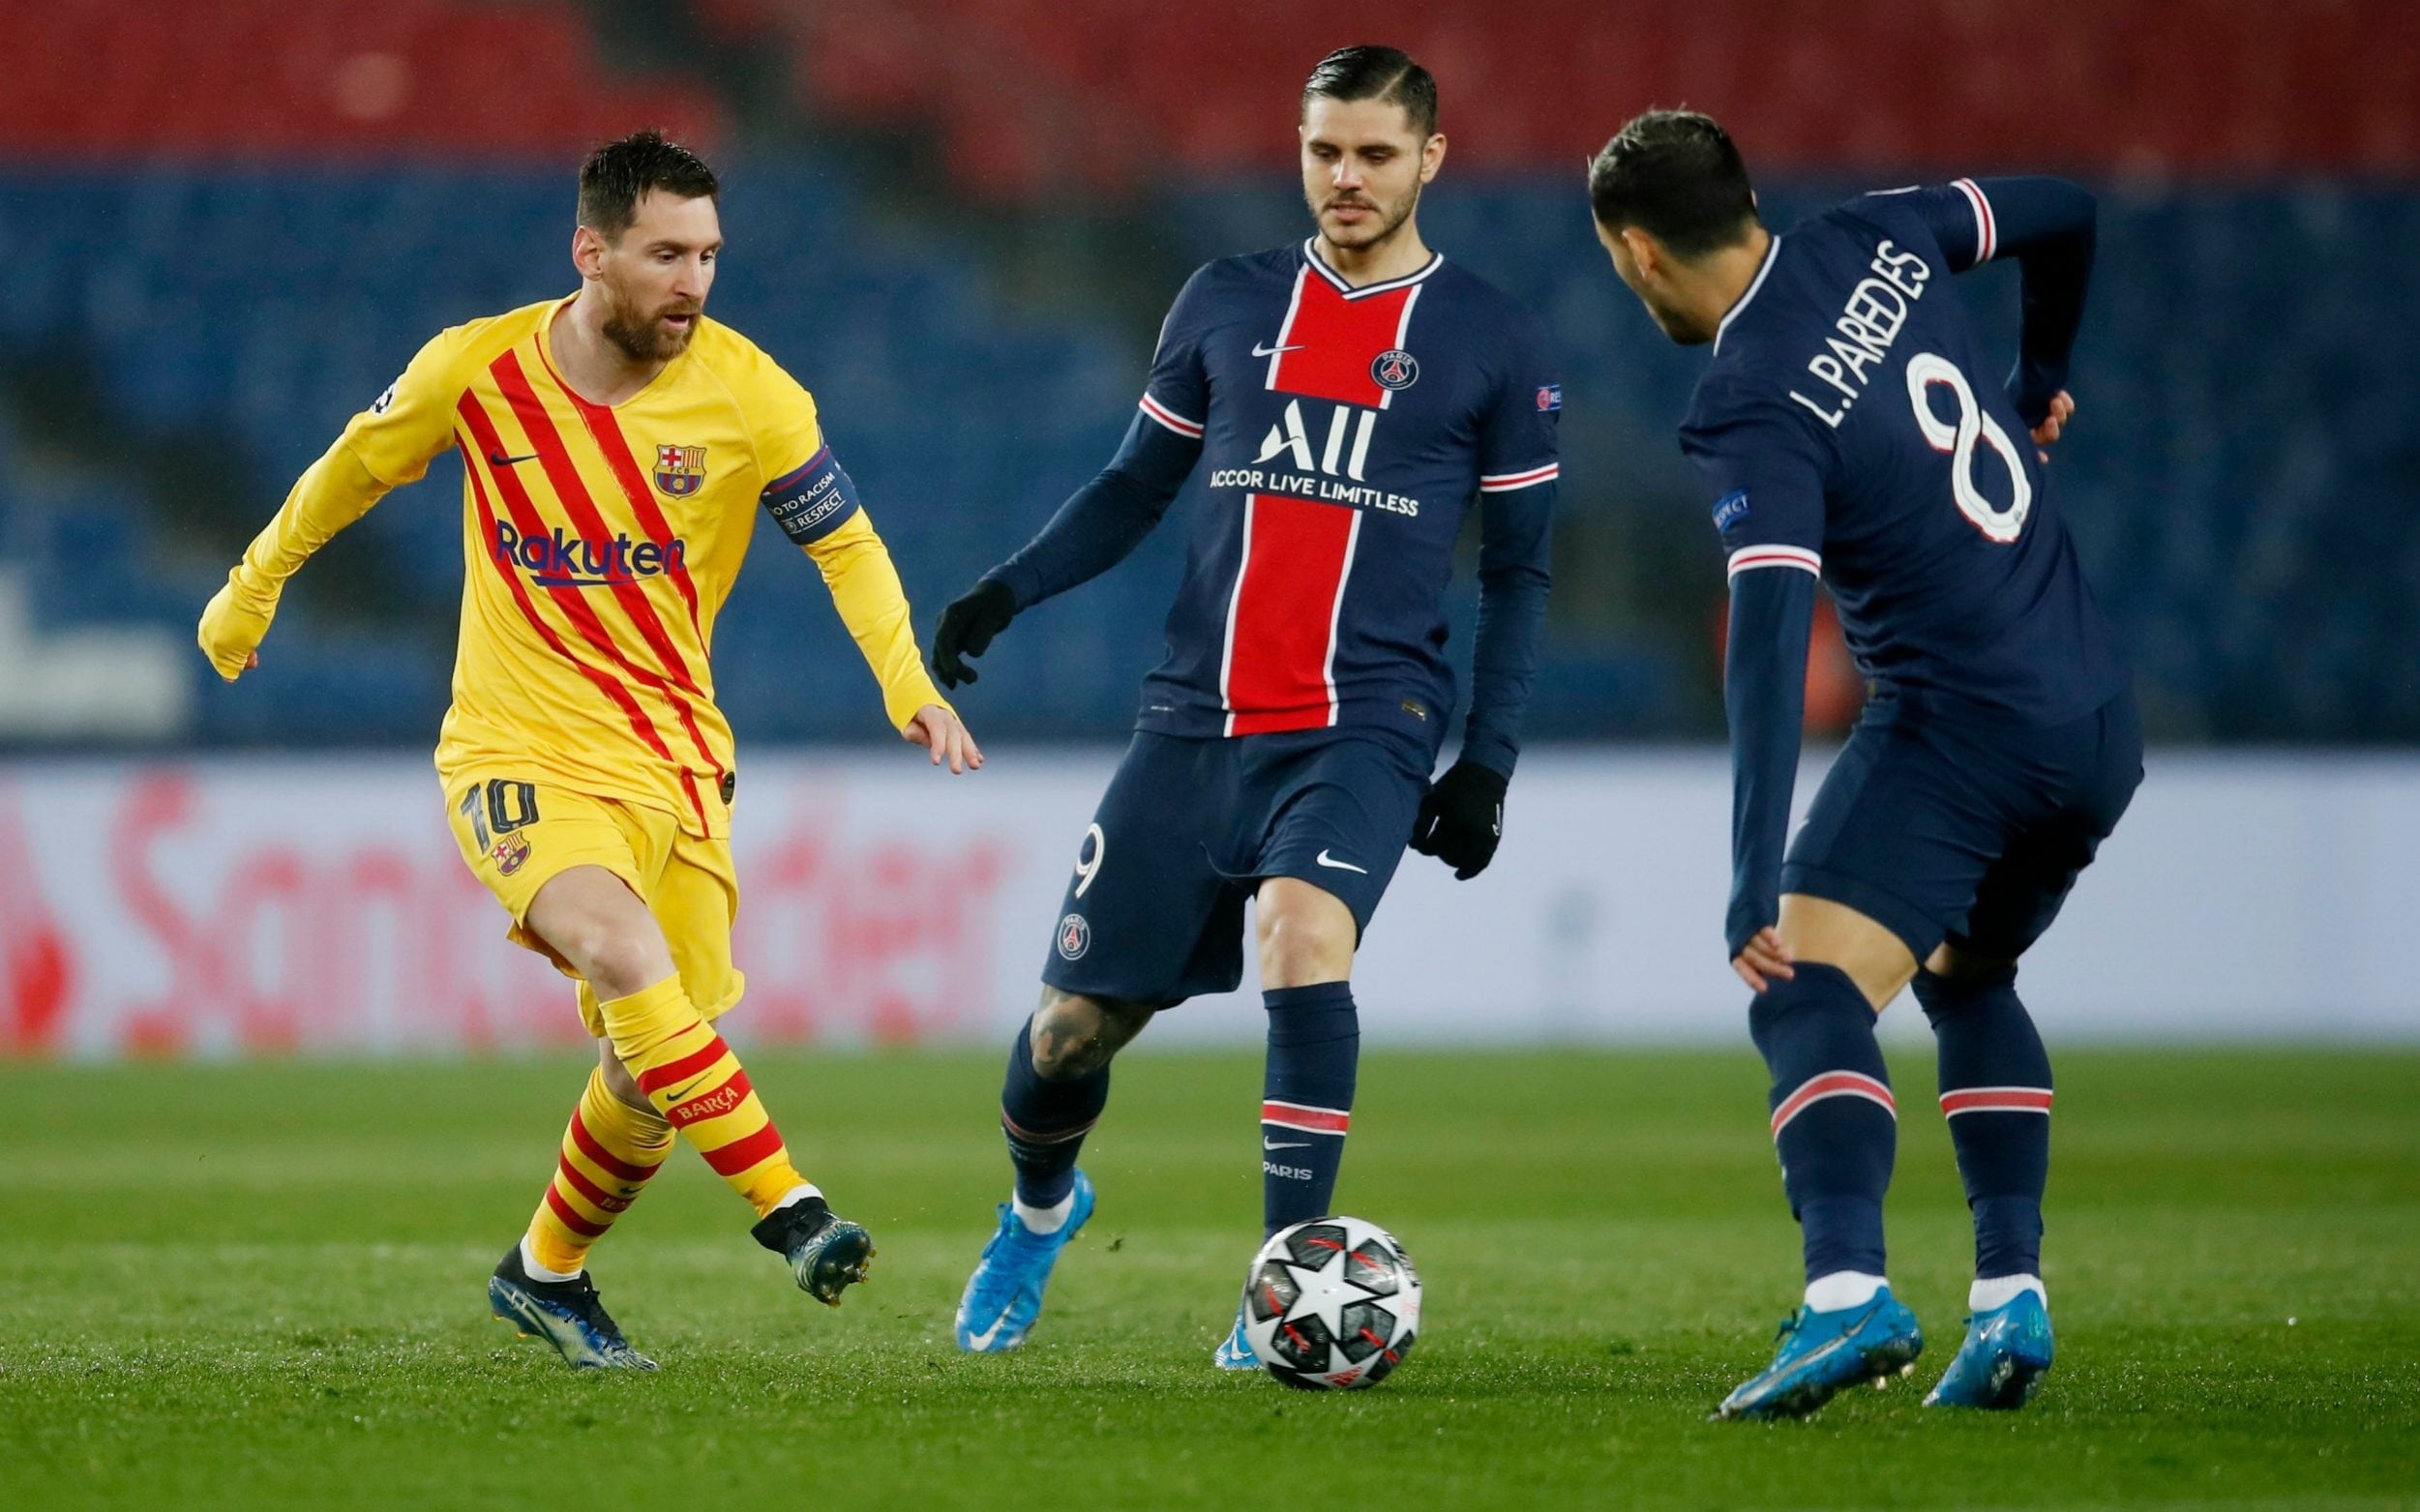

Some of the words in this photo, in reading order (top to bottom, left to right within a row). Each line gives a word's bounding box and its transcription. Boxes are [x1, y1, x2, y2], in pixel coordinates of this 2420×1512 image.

[1789, 239, 1930, 428] L.PAREDES
[1382, 352, 1414, 366] PARIS
[1906, 351, 2032, 544] 8
[782, 500, 798, 513] TO
[798, 471, 836, 505] RACISM
[796, 490, 843, 527] RESPECT
[1210, 469, 1264, 489] ACCOR
[1269, 473, 1316, 495] LIVE
[1319, 481, 1419, 518] LIMITLESS
[496, 519, 685, 576] Rakuten
[460, 778, 540, 856] 10
[1075, 821, 1105, 899] 9
[677, 1086, 738, 1120] BARÇA
[1263, 1161, 1313, 1180] PARIS
